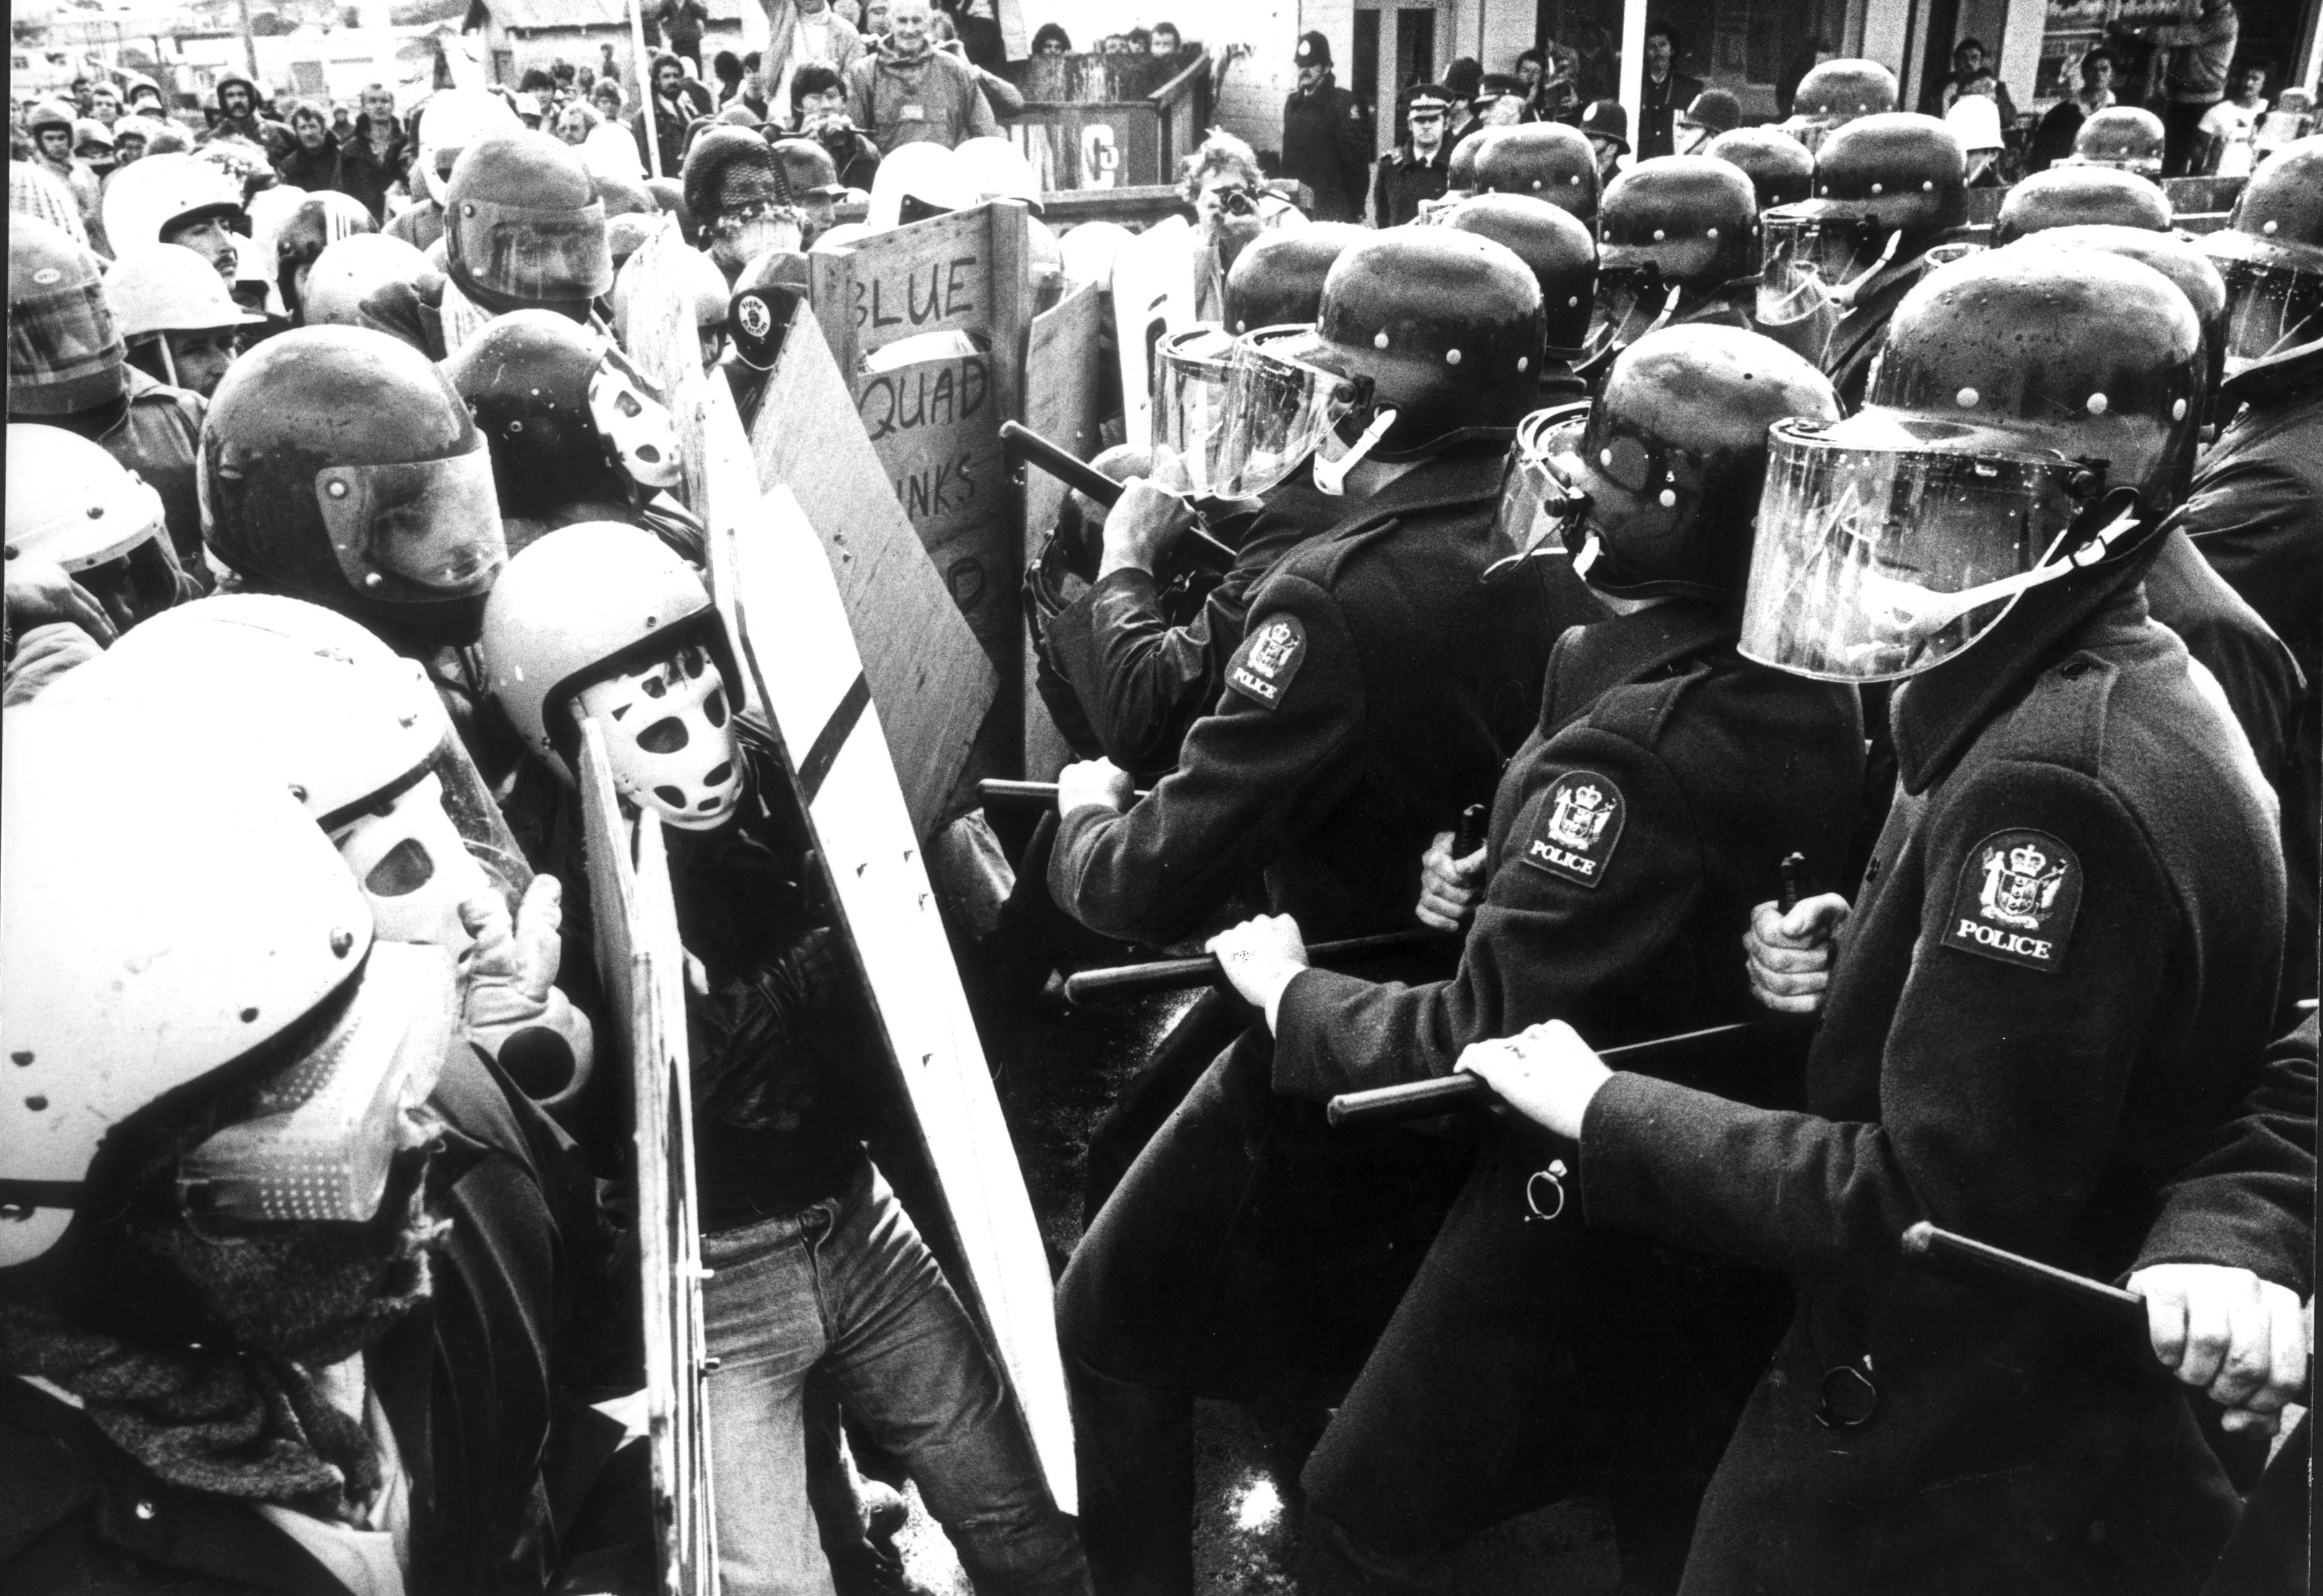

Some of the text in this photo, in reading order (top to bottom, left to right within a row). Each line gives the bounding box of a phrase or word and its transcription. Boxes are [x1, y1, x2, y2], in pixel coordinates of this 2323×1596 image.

[859, 357, 987, 441] QUAD
[897, 453, 976, 523] INKS
[1233, 667, 1278, 699] POLICE
[1529, 839, 1596, 875] POLICE
[1956, 918, 2052, 959] POLICE
